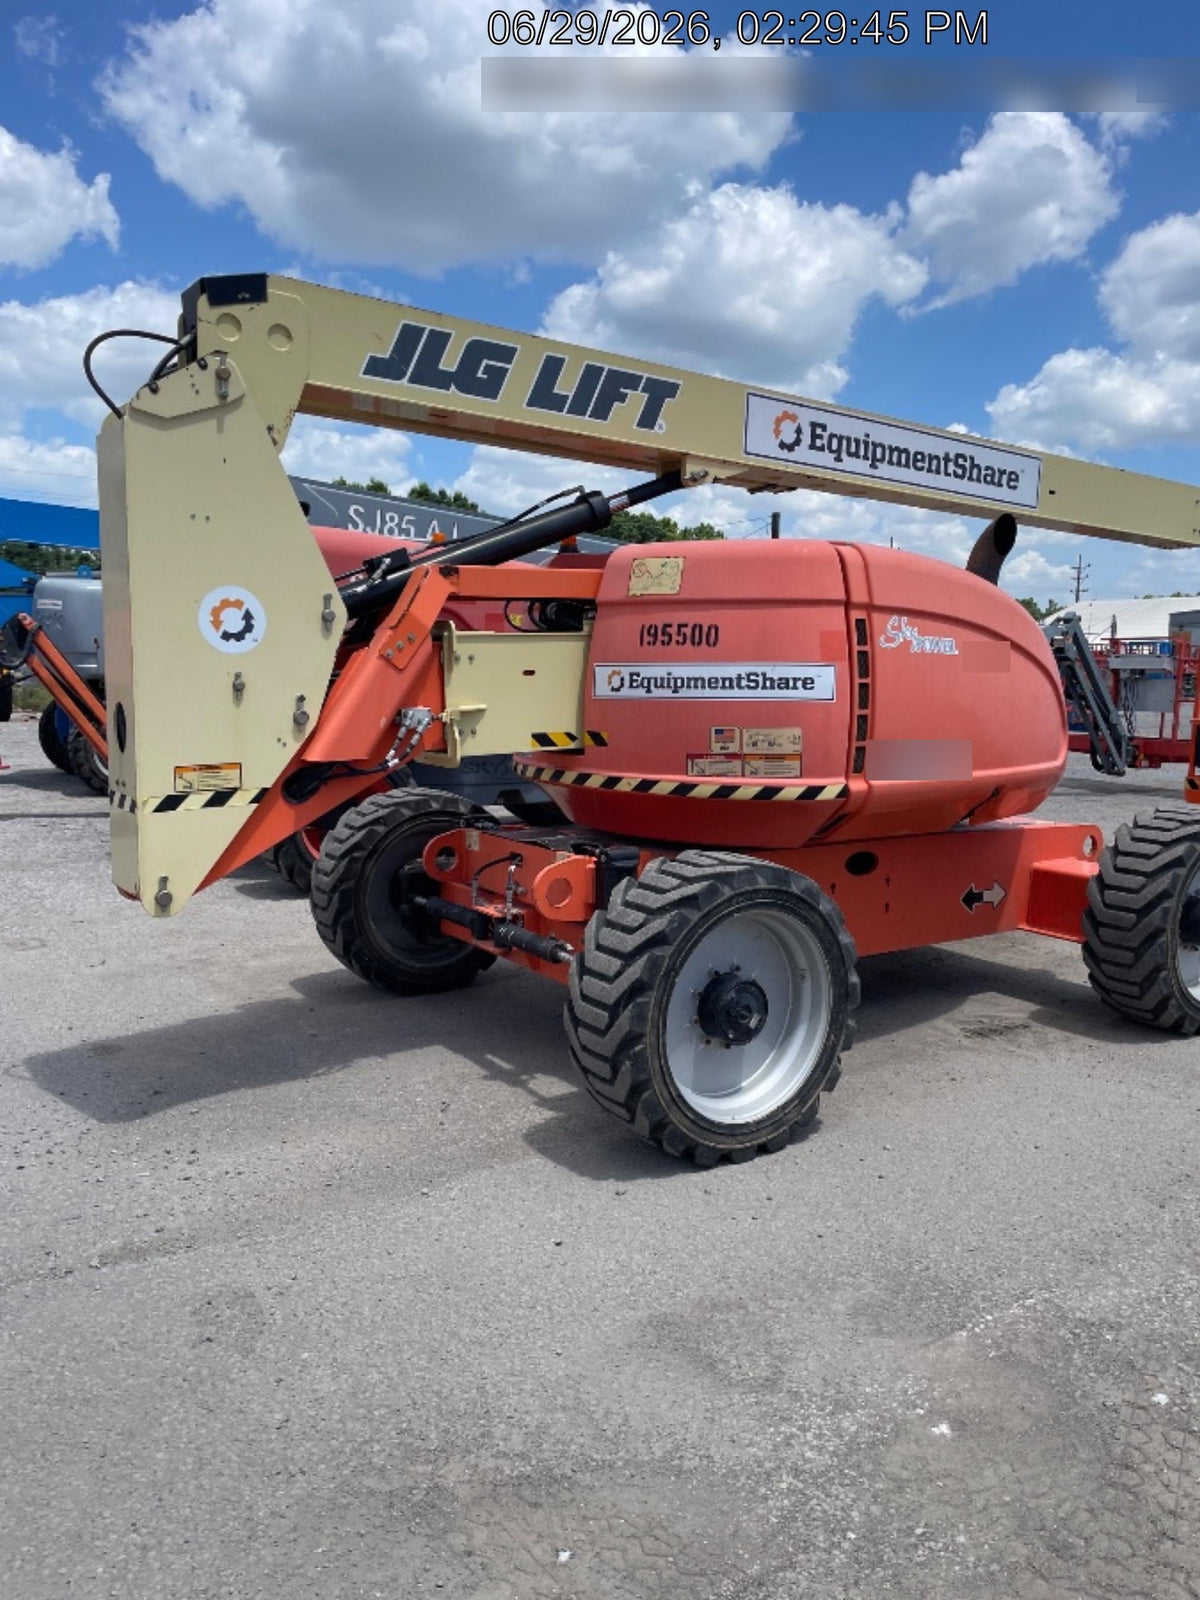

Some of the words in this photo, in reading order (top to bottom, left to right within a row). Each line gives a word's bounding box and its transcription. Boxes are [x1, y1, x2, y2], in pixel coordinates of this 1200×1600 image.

[359, 320, 520, 402] JLG
[523, 352, 682, 432] LIFT
[808, 420, 1020, 490] EquipmentShare
[639, 623, 720, 648] 195500
[628, 671, 816, 694] EquipmentShare
